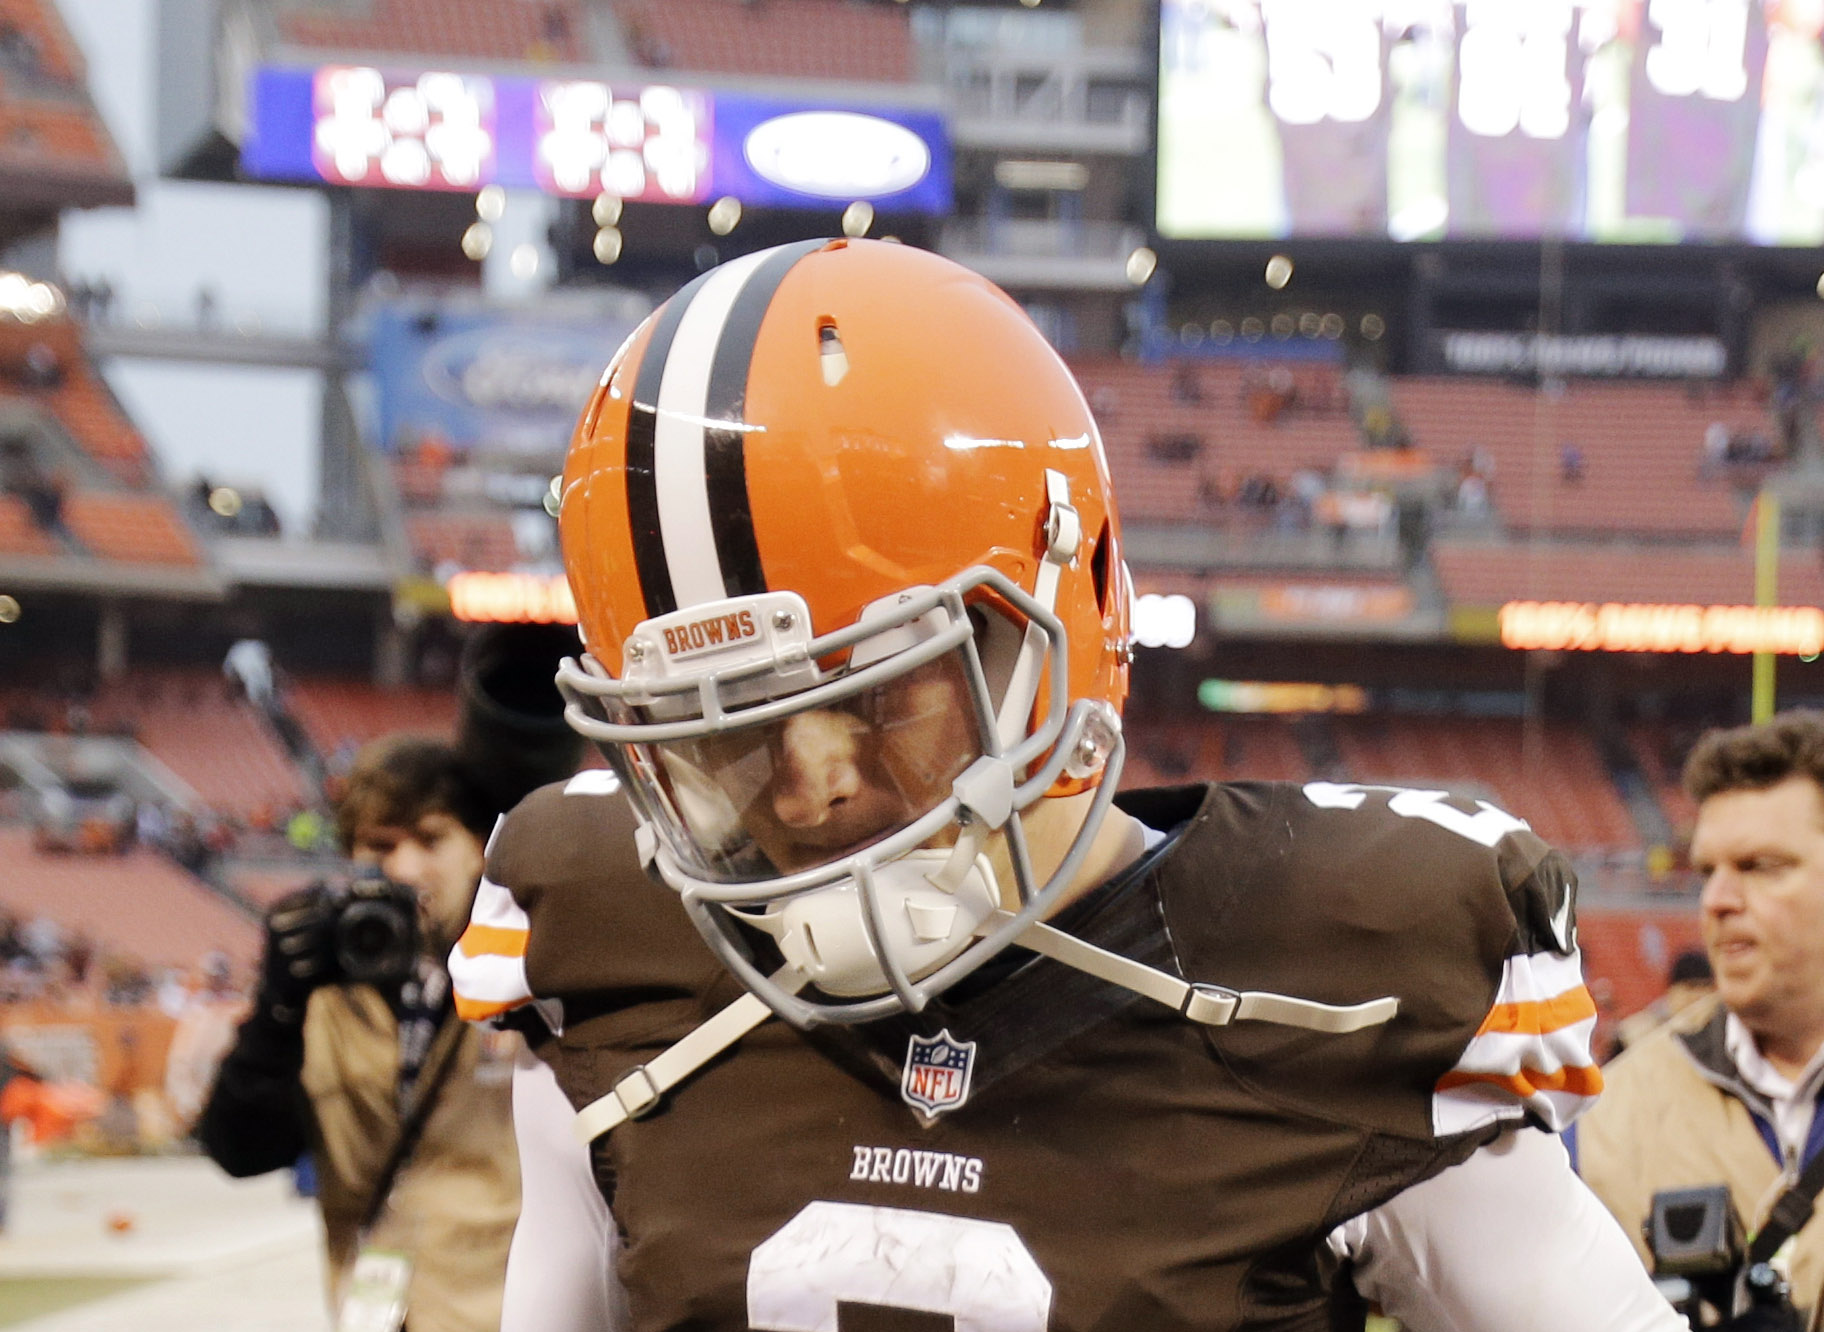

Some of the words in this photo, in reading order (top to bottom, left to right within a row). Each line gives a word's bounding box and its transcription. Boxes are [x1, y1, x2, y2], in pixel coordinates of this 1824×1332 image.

[663, 610, 755, 654] BROWNS
[911, 1066, 958, 1101] NFL
[850, 1145, 983, 1193] BROWNS
